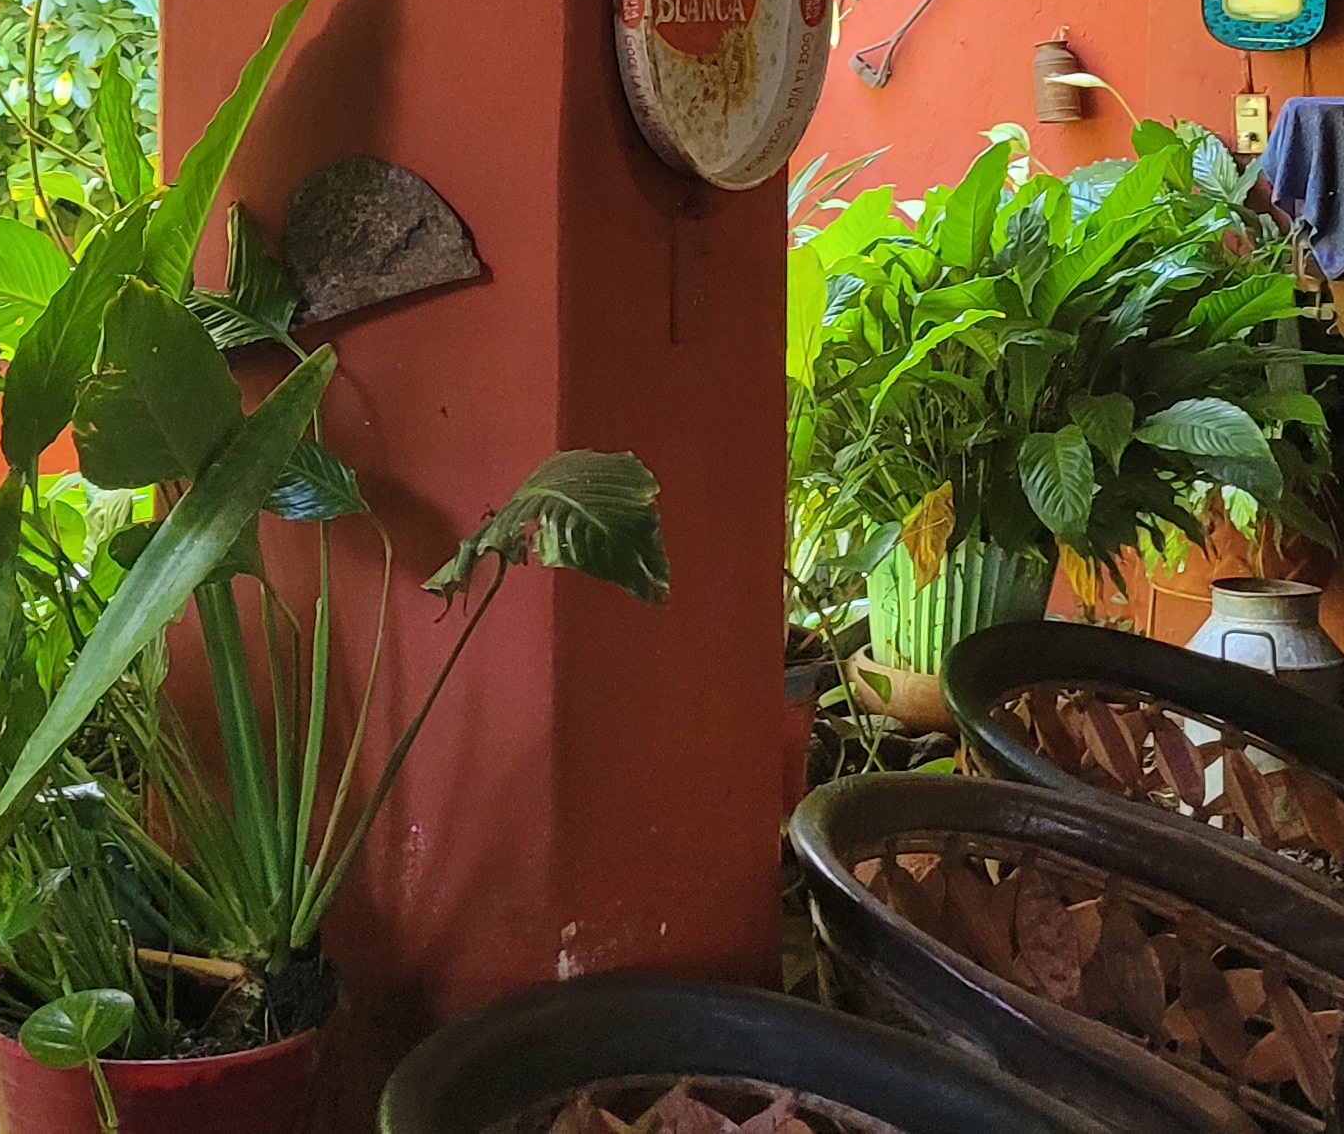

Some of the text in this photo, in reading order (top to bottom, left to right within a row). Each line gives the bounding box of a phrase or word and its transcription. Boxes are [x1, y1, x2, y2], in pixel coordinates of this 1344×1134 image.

[625, 34, 639, 71] GOCE
[785, 32, 815, 111] GOCE LA VIDA
